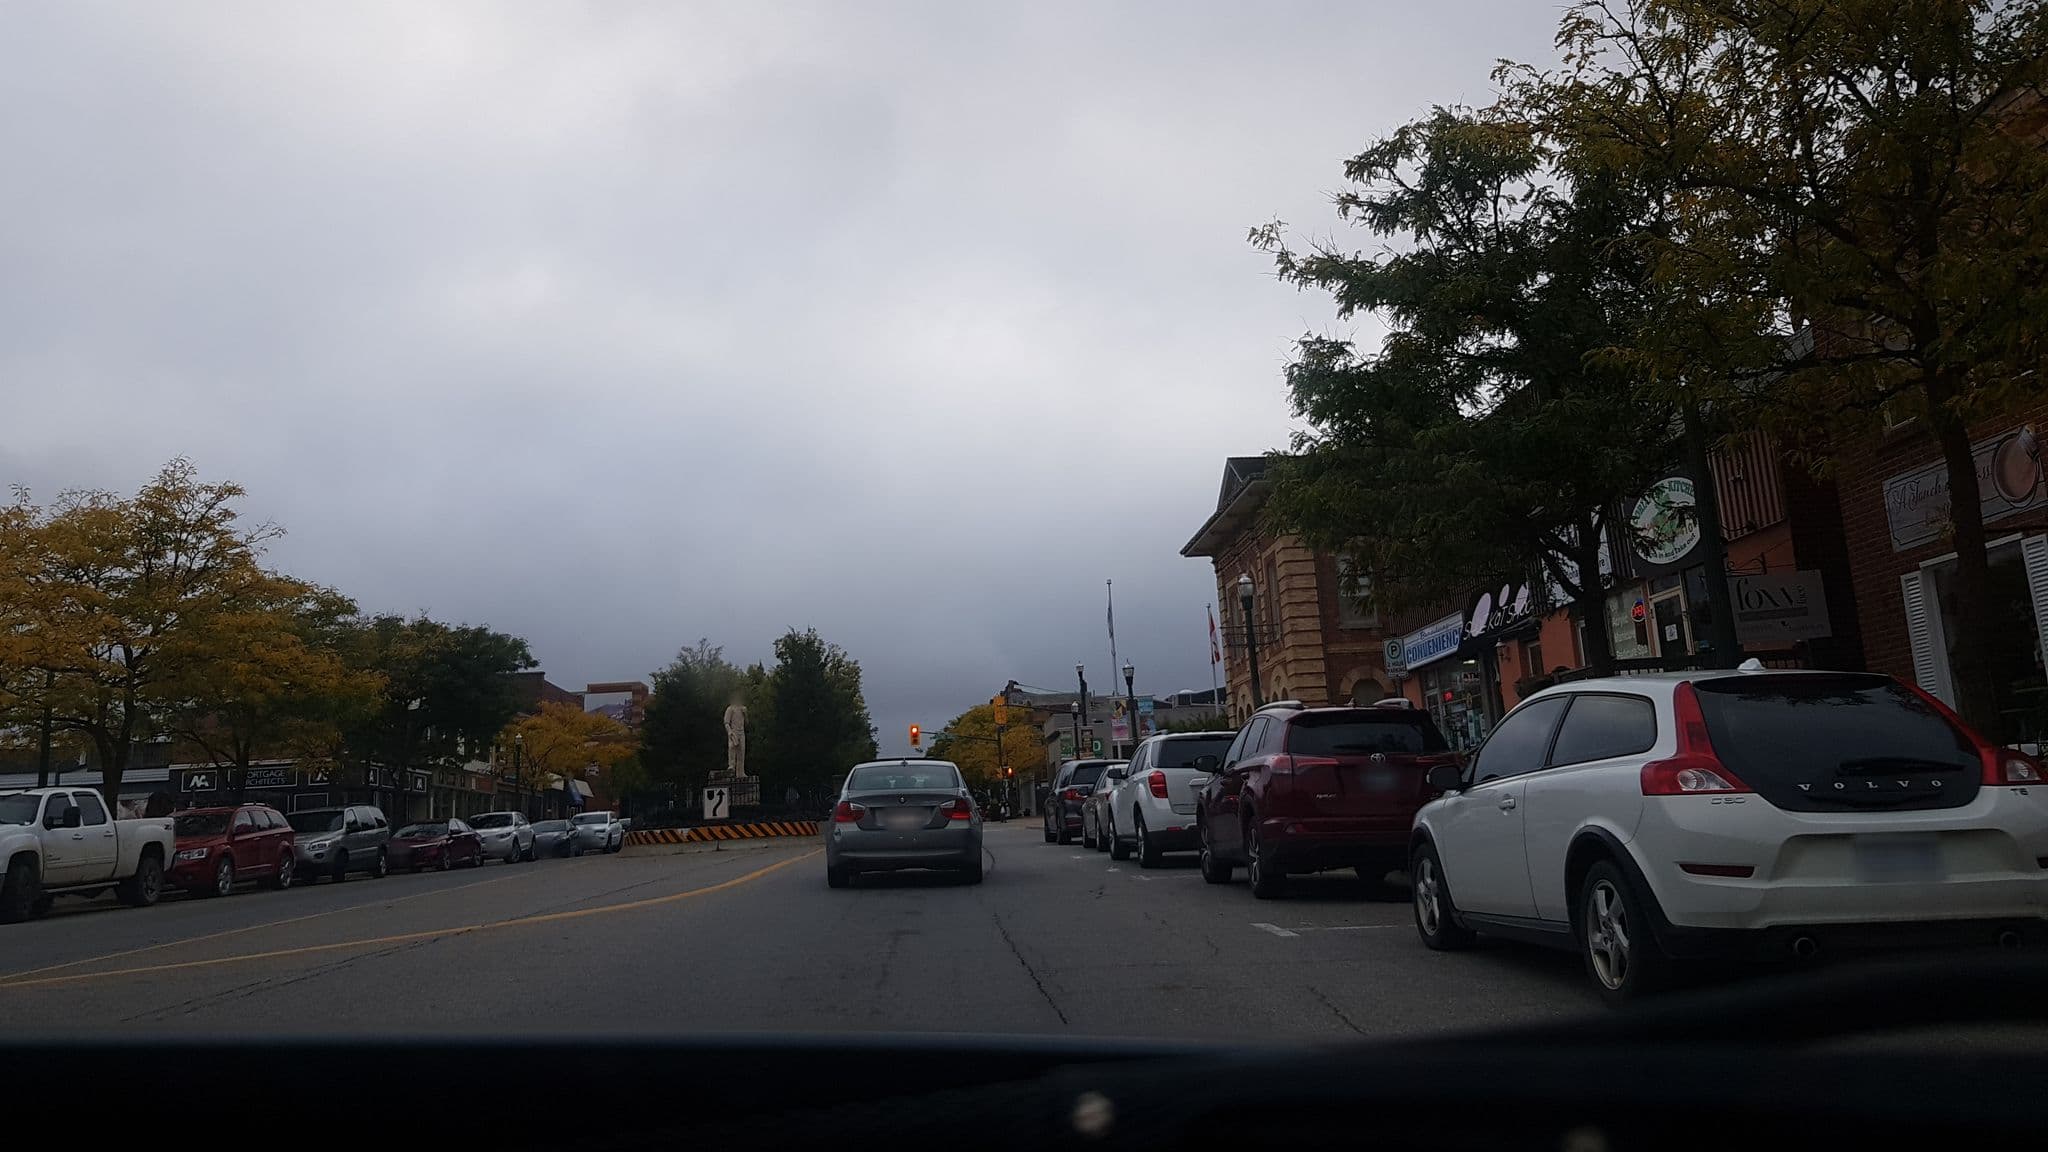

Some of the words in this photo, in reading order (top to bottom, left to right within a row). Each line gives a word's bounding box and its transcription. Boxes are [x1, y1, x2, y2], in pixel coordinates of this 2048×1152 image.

[1667, 479, 1695, 498] KITCHE
[247, 769, 287, 778] ORTGAGE
[1797, 779, 1943, 792] VOLVO
